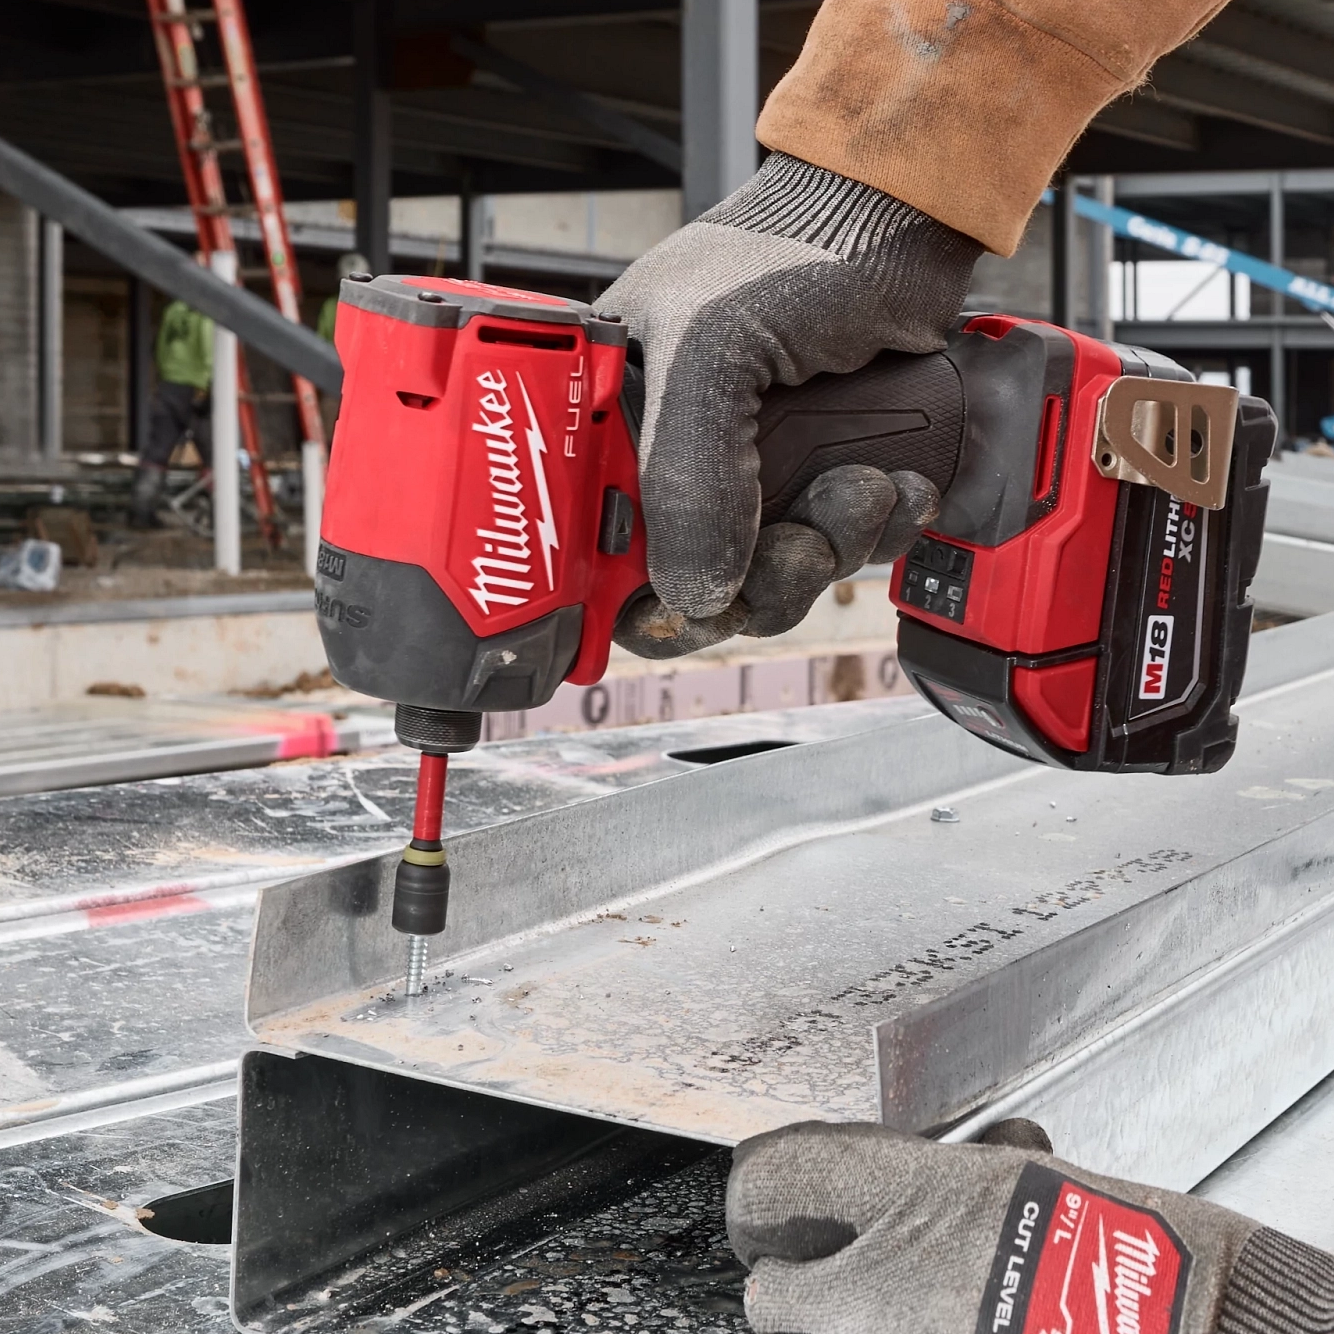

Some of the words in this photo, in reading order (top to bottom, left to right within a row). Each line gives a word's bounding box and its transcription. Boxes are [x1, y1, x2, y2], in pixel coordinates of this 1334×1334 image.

[564, 355, 584, 457] FUEL
[468, 369, 535, 616] Milwaukee
[923, 594, 932, 610] 2
[948, 602, 956, 618] 3
[1143, 620, 1168, 694] M18
[1014, 1201, 1040, 1252] CUT
[992, 1255, 1025, 1333] LEVEL
